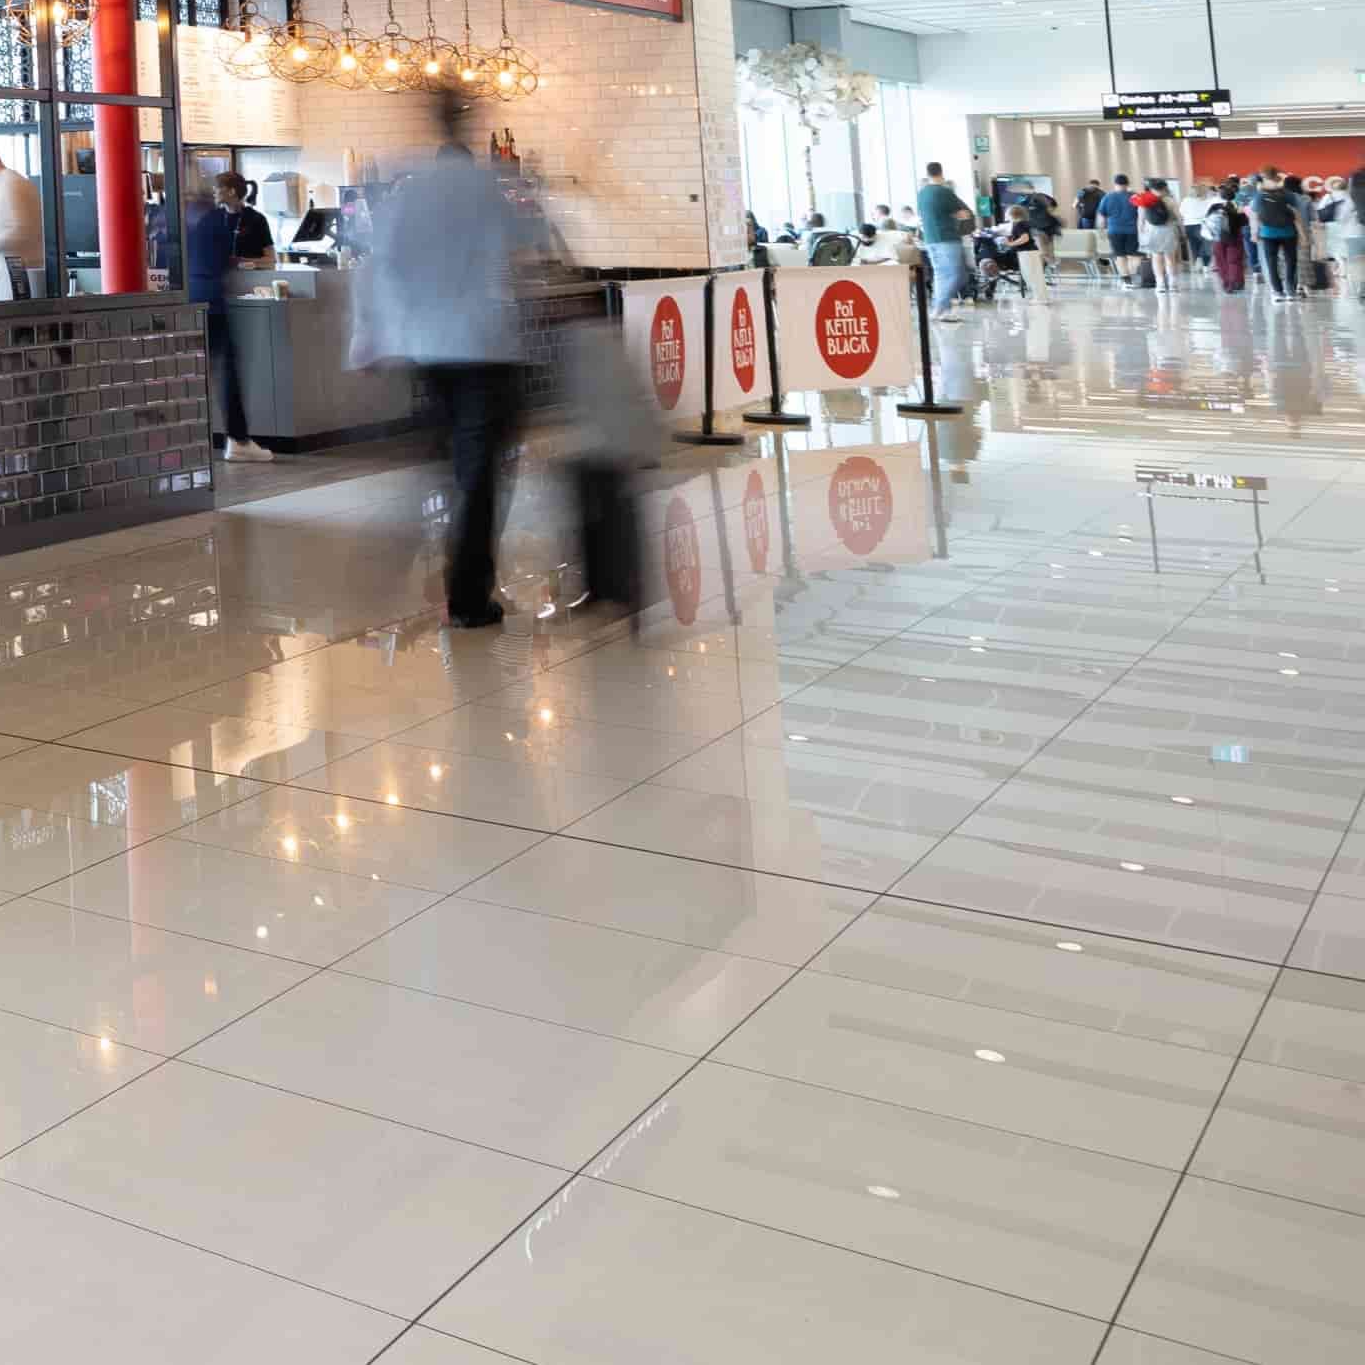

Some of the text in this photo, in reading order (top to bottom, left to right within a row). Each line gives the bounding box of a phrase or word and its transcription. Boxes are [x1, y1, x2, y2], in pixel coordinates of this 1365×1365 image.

[825, 316, 870, 336] KETTLE
[653, 339, 682, 363] KETTLE
[827, 336, 871, 356] BLACK
